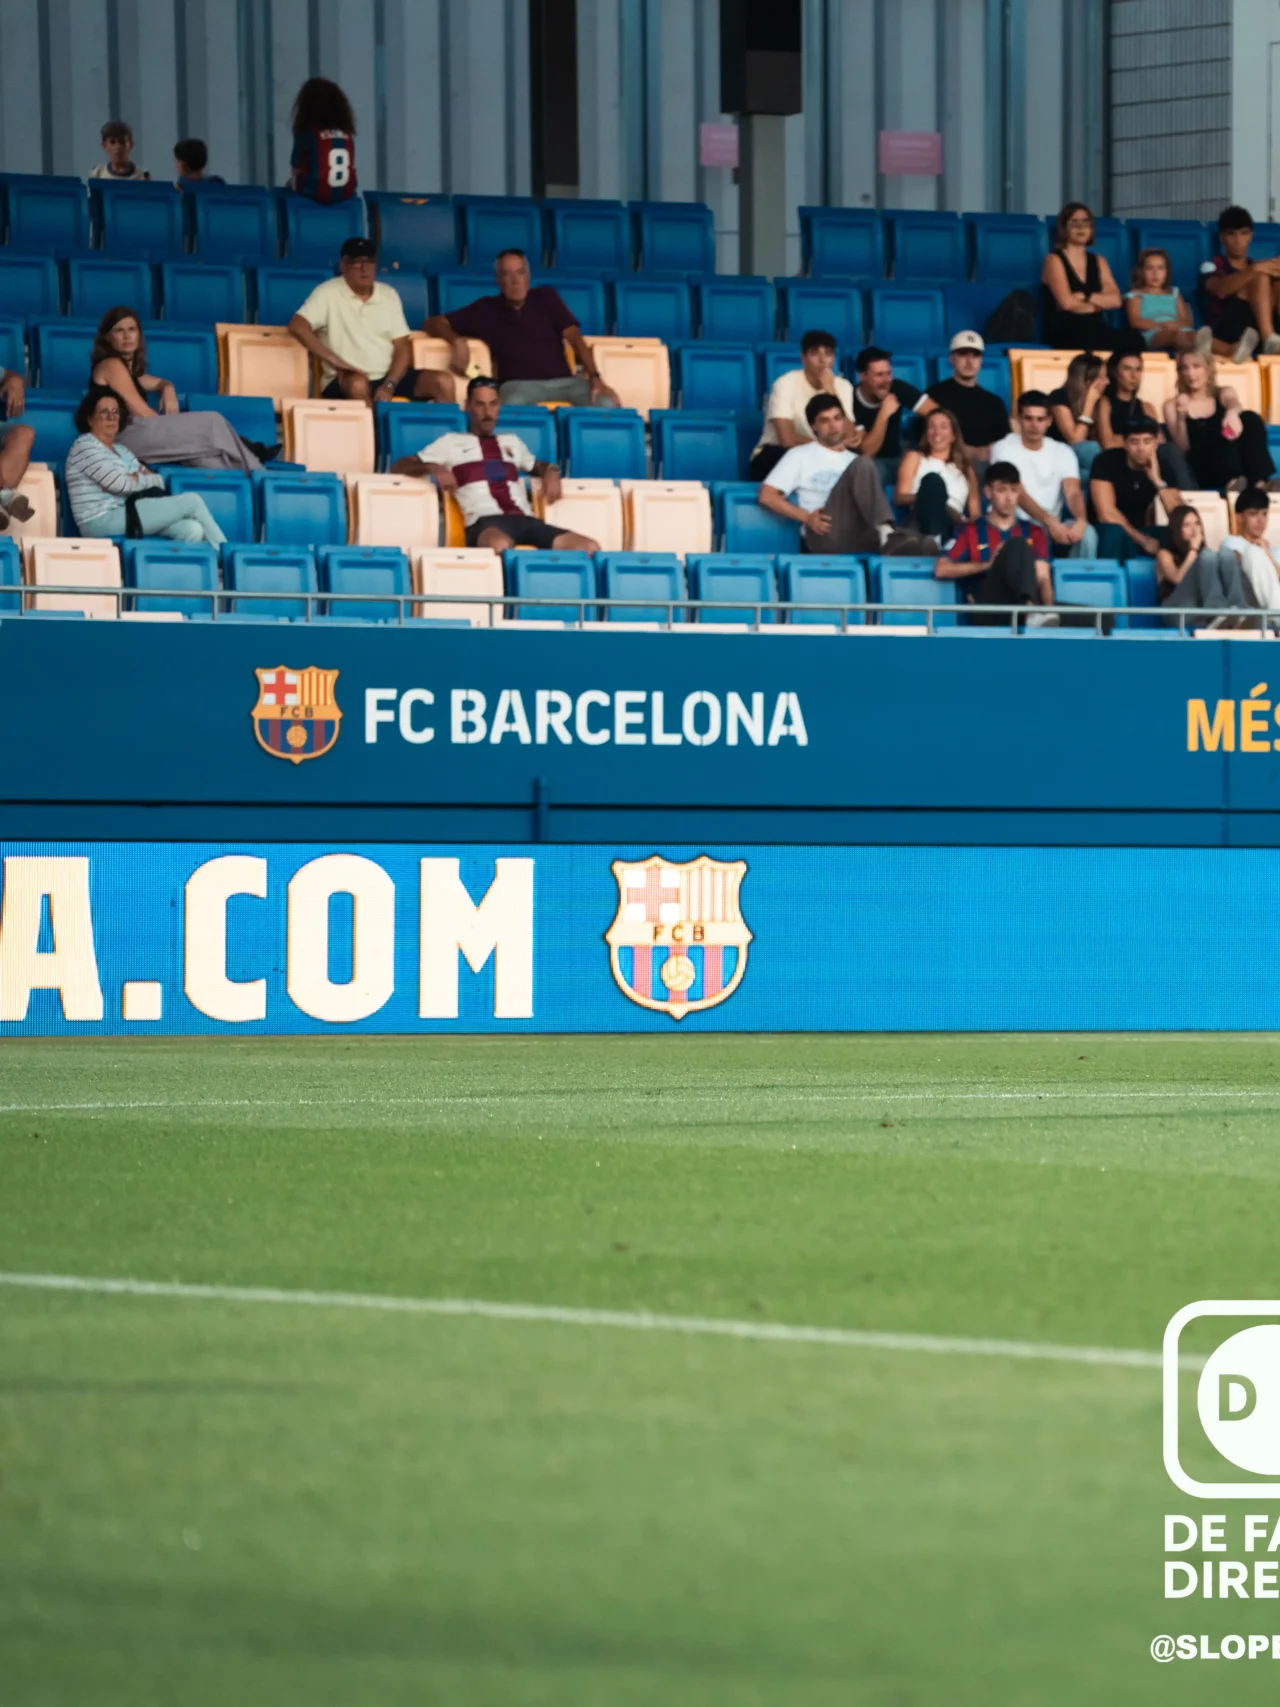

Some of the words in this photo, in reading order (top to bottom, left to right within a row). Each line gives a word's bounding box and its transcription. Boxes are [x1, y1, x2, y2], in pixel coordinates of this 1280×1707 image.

[328, 148, 350, 188] 8
[365, 688, 435, 744] FC
[451, 689, 808, 746] BARCELONA
